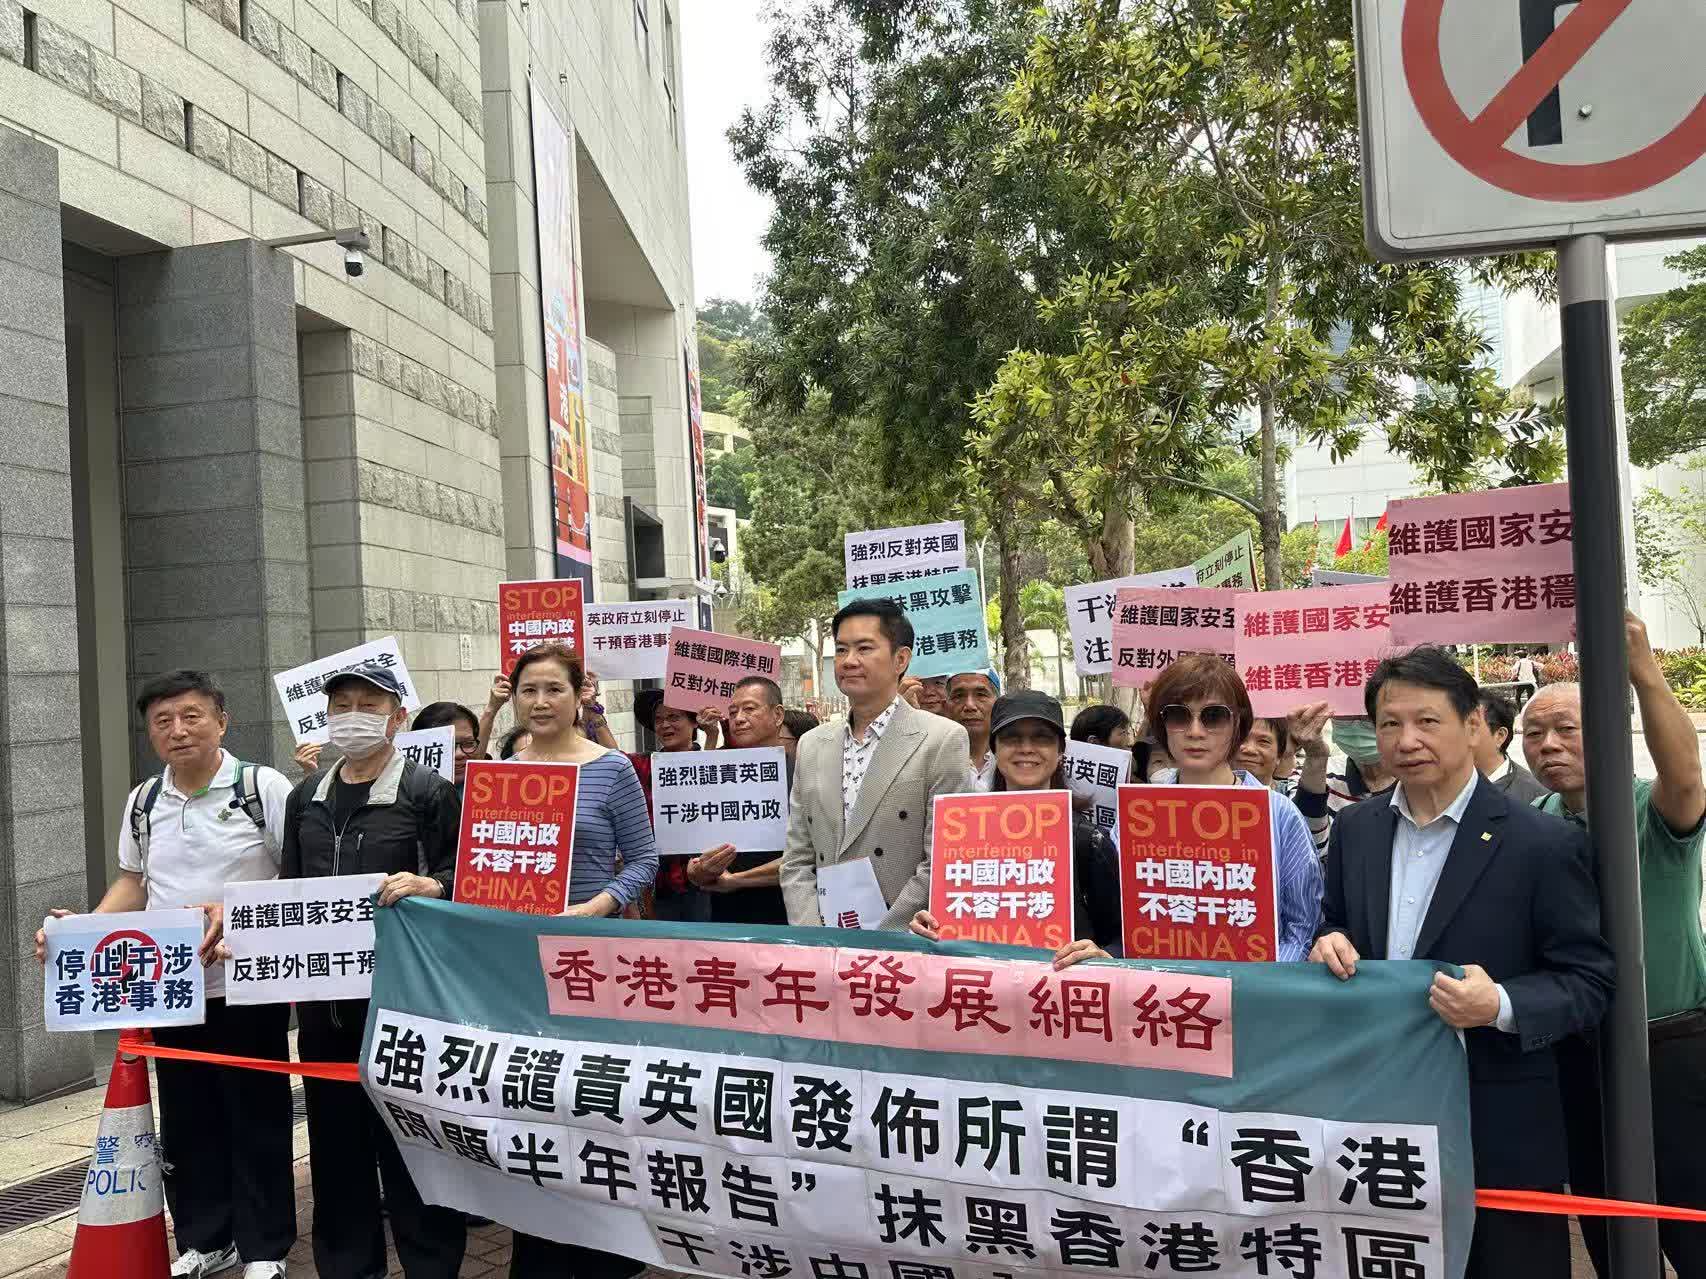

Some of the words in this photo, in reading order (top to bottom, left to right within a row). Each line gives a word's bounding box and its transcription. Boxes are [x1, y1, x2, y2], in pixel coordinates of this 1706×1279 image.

[851, 534, 959, 562] 強烈反對英國
[504, 586, 577, 610] STOP
[1389, 573, 1575, 615] 維護香港穩
[508, 618, 575, 637] 中國內政
[587, 609, 686, 626] 英政府立刻停止
[1244, 603, 1390, 638] 維護國家安
[593, 633, 672, 651] 干預香港事
[674, 640, 774, 674] 維護國際準則
[658, 761, 779, 787] 強烈譴責英國
[471, 772, 570, 806] STOP
[471, 806, 545, 822] interfering
[552, 808, 564, 822] in
[660, 799, 781, 824] 干涉中國內政
[943, 803, 1062, 840] STOP
[1128, 799, 1261, 840] STOP
[471, 820, 561, 847] 中國內政
[470, 847, 557, 875] 不容干涉
[944, 843, 1033, 859] interfering
[1043, 841, 1058, 857] in
[1132, 840, 1231, 862] interfering
[1242, 843, 1259, 862] in
[945, 858, 1056, 887] 中國內政
[1135, 858, 1257, 892] 中國內政
[231, 897, 374, 931] 維護國家安全
[945, 890, 1055, 919] 不容干涉
[1138, 892, 1257, 927] 不容干涉
[55, 944, 194, 981] 停止干涉
[55, 977, 194, 1016] 香港事務
[549, 949, 1223, 1051] 香港青年發展網絡
